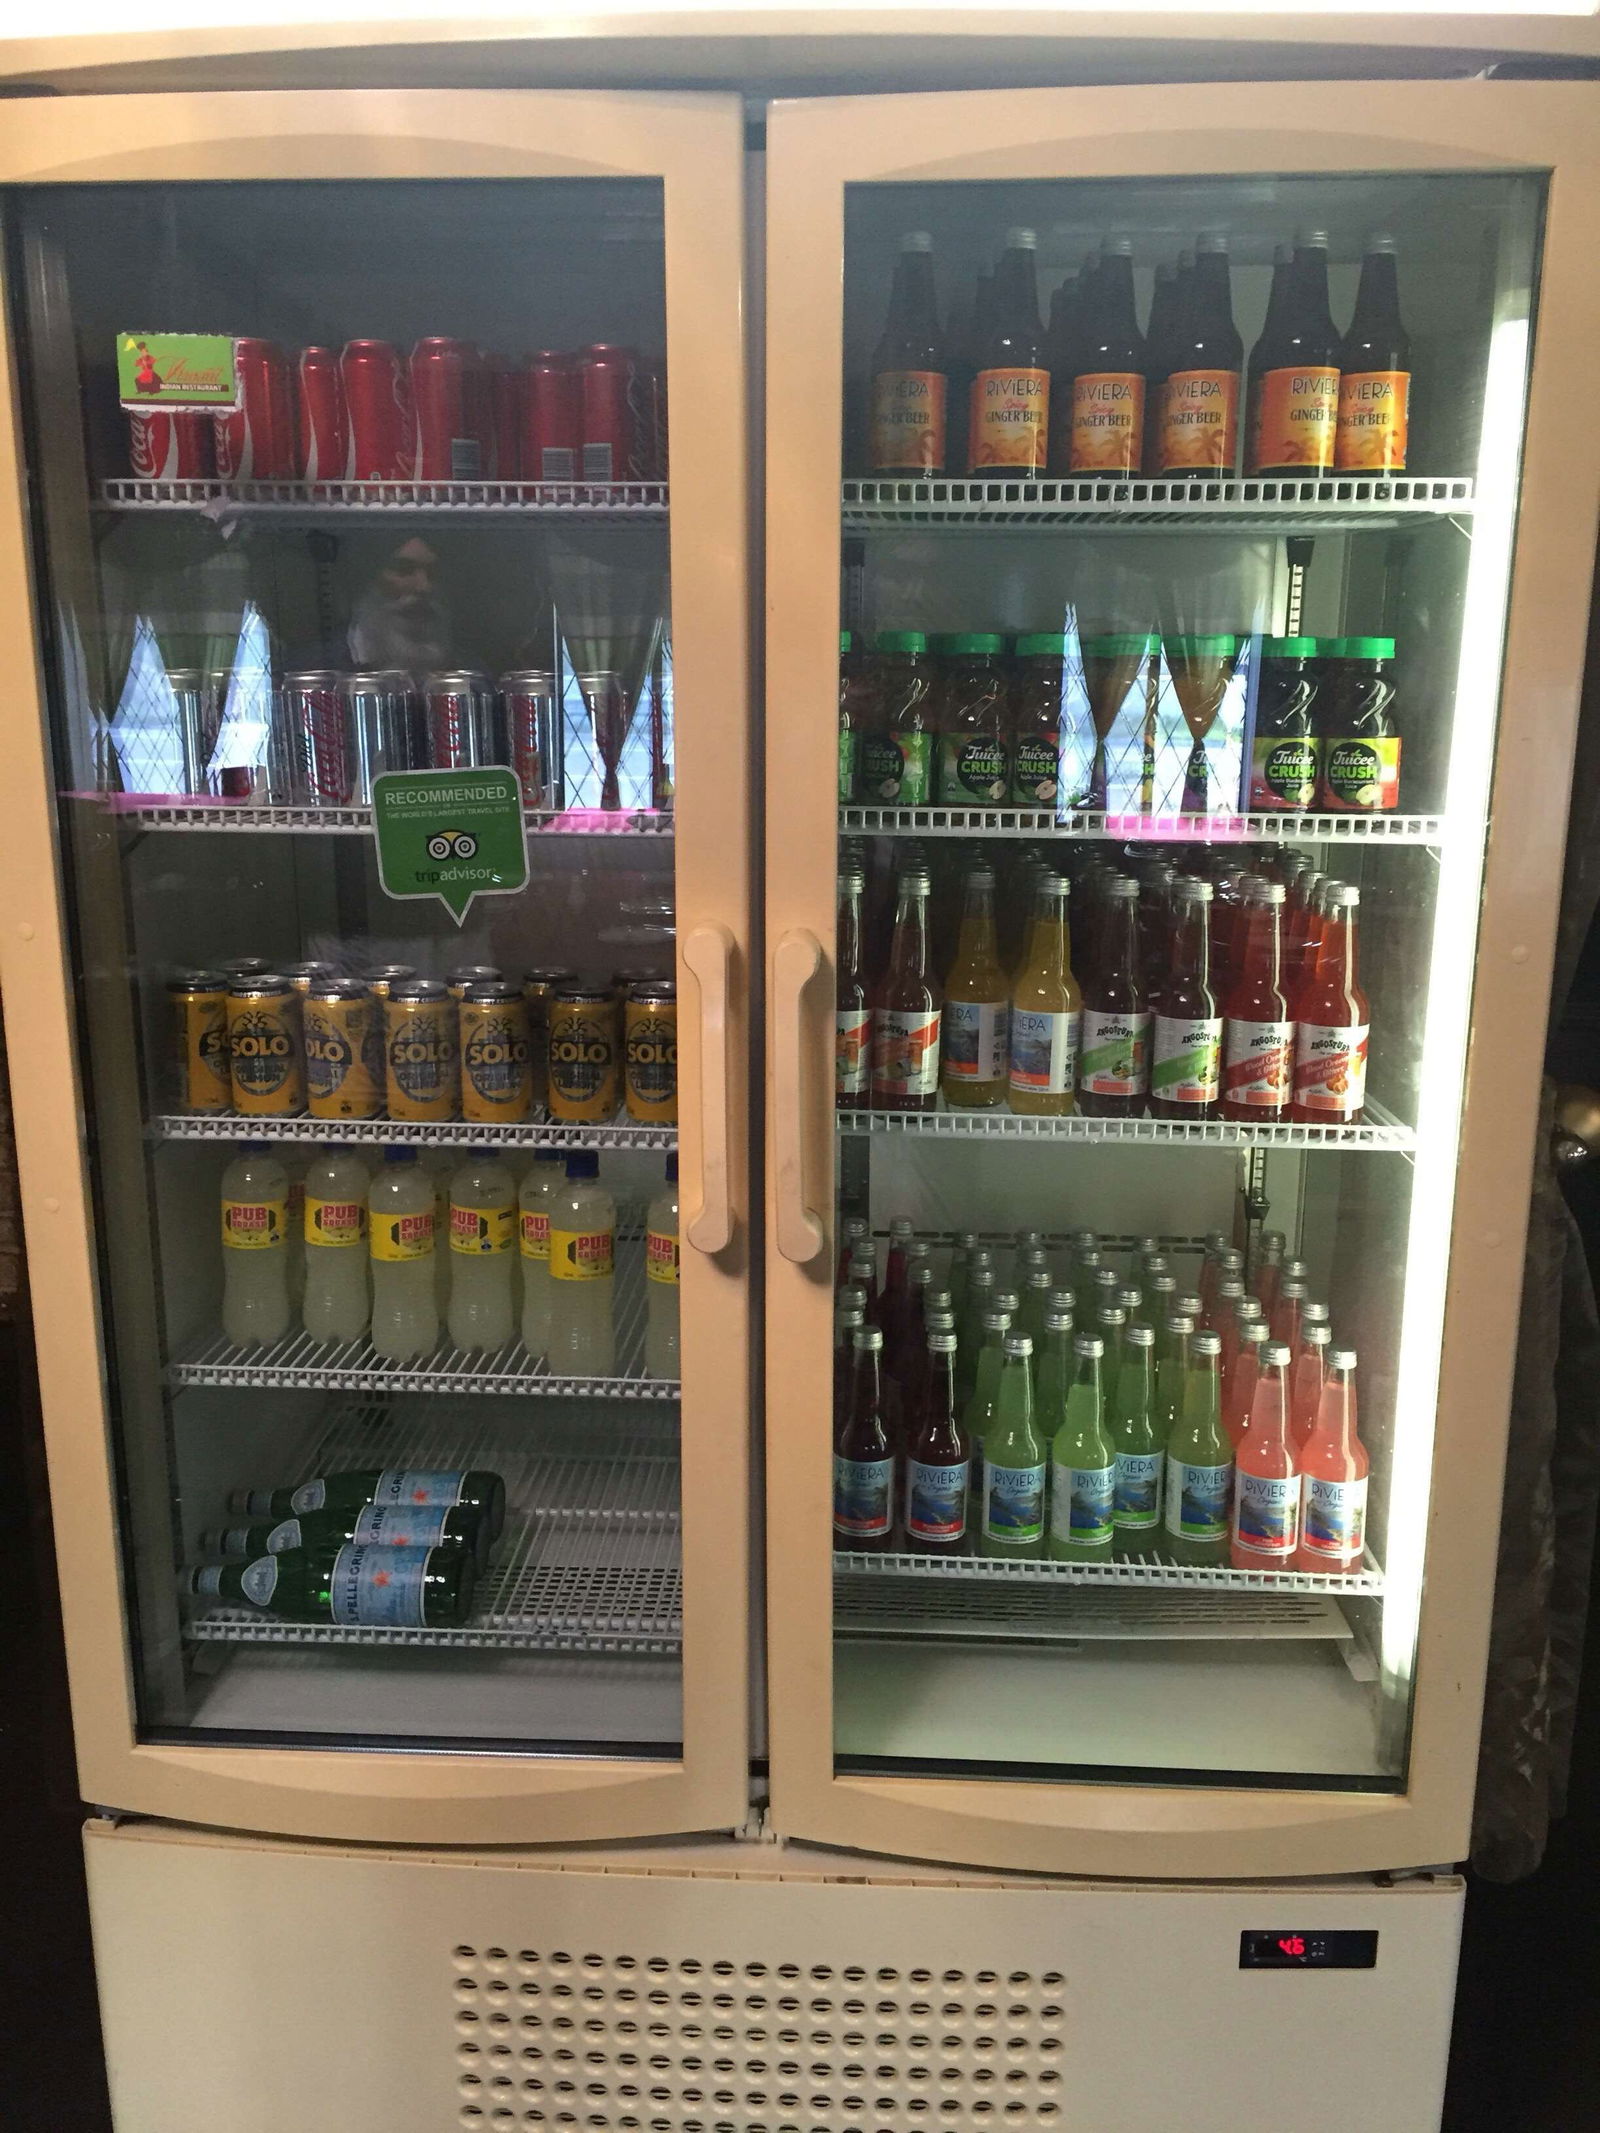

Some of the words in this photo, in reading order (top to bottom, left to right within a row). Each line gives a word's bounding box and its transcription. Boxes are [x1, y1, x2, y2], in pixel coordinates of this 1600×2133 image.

[182, 384, 222, 392] RESTAURANT
[1196, 411, 1222, 424] BEER
[1019, 745, 1054, 760] Juicee
[1273, 750, 1314, 765] Juicee
[1333, 750, 1376, 766] Juicee
[1268, 765, 1315, 778] CRUSH
[1331, 765, 1378, 779] CRUSH
[384, 786, 508, 805] RECOMMENDED
[468, 807, 493, 815] TRAVEL
[415, 866, 493, 884] tripadvisor
[231, 1036, 290, 1057] SOLO
[394, 1042, 451, 1065] SOLO
[469, 1043, 528, 1065] SOLO
[551, 1042, 608, 1062] SOLO
[232, 1206, 267, 1221] PUB
[323, 1205, 357, 1219] PUB
[451, 1207, 478, 1226] PUB
[401, 1216, 432, 1232] PUB
[577, 1234, 610, 1251] PUB
